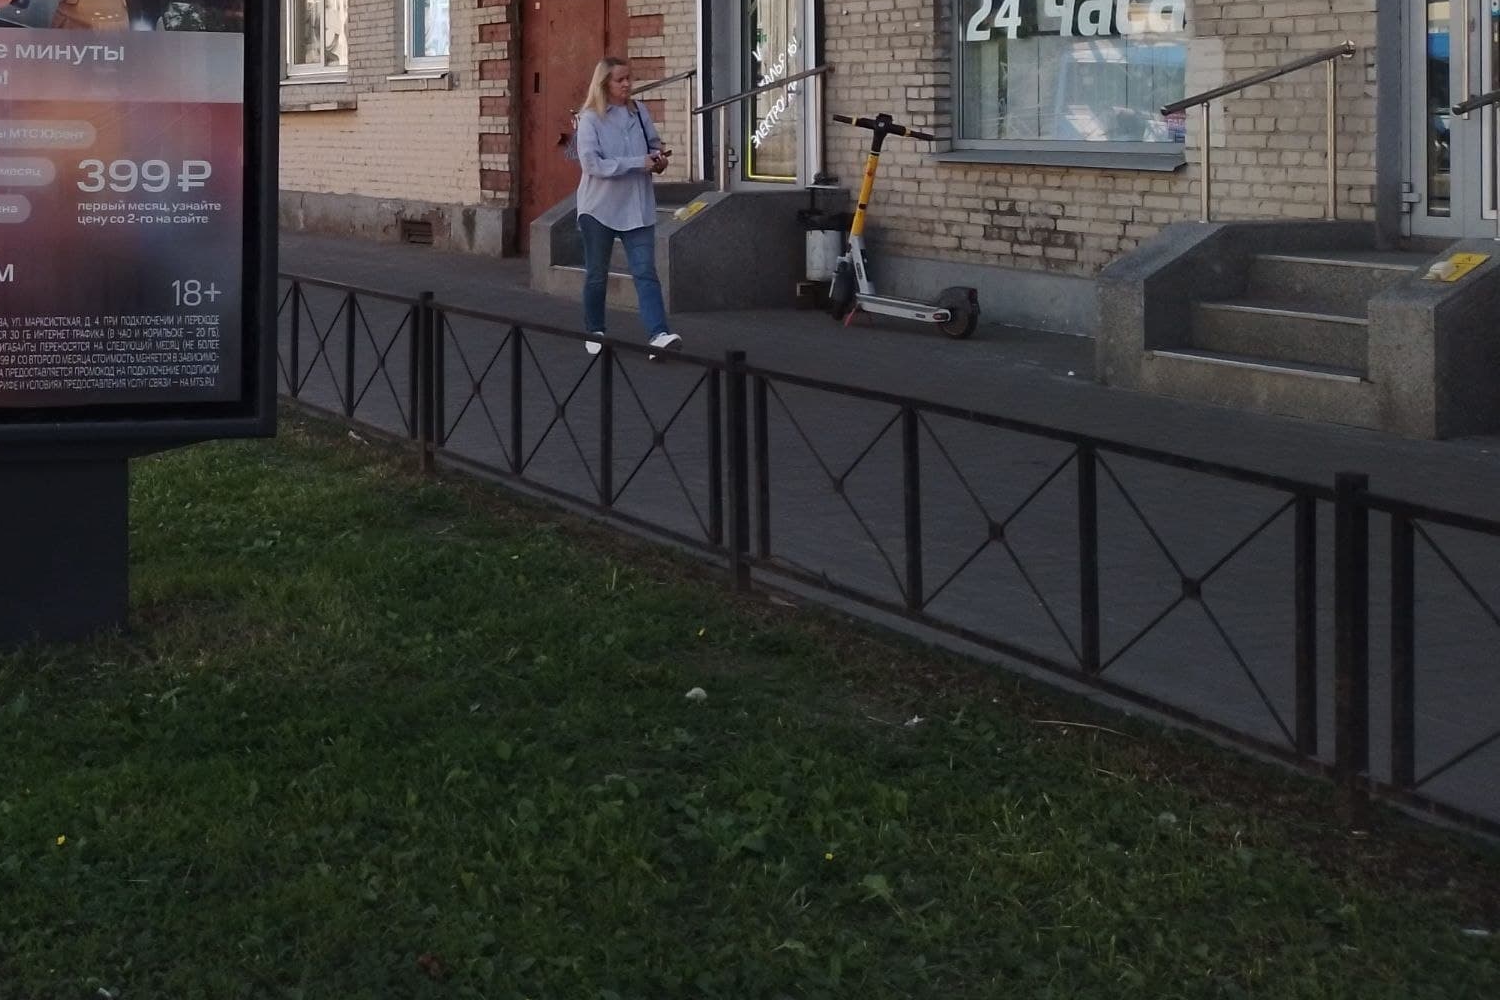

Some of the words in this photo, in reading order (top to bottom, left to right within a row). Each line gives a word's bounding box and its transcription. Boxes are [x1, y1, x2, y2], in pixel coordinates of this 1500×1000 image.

[15, 44, 125, 65] минуты
[9, 127, 39, 139] МТС
[1, 168, 42, 179] месяц
[77, 200, 126, 213] первый
[172, 200, 221, 213] узнайте
[77, 215, 108, 226] цену
[110, 216, 125, 224] со
[127, 213, 153, 224] 2-го
[155, 216, 171, 224] на
[173, 212, 209, 224] сайте
[171, 279, 222, 306] 18+
